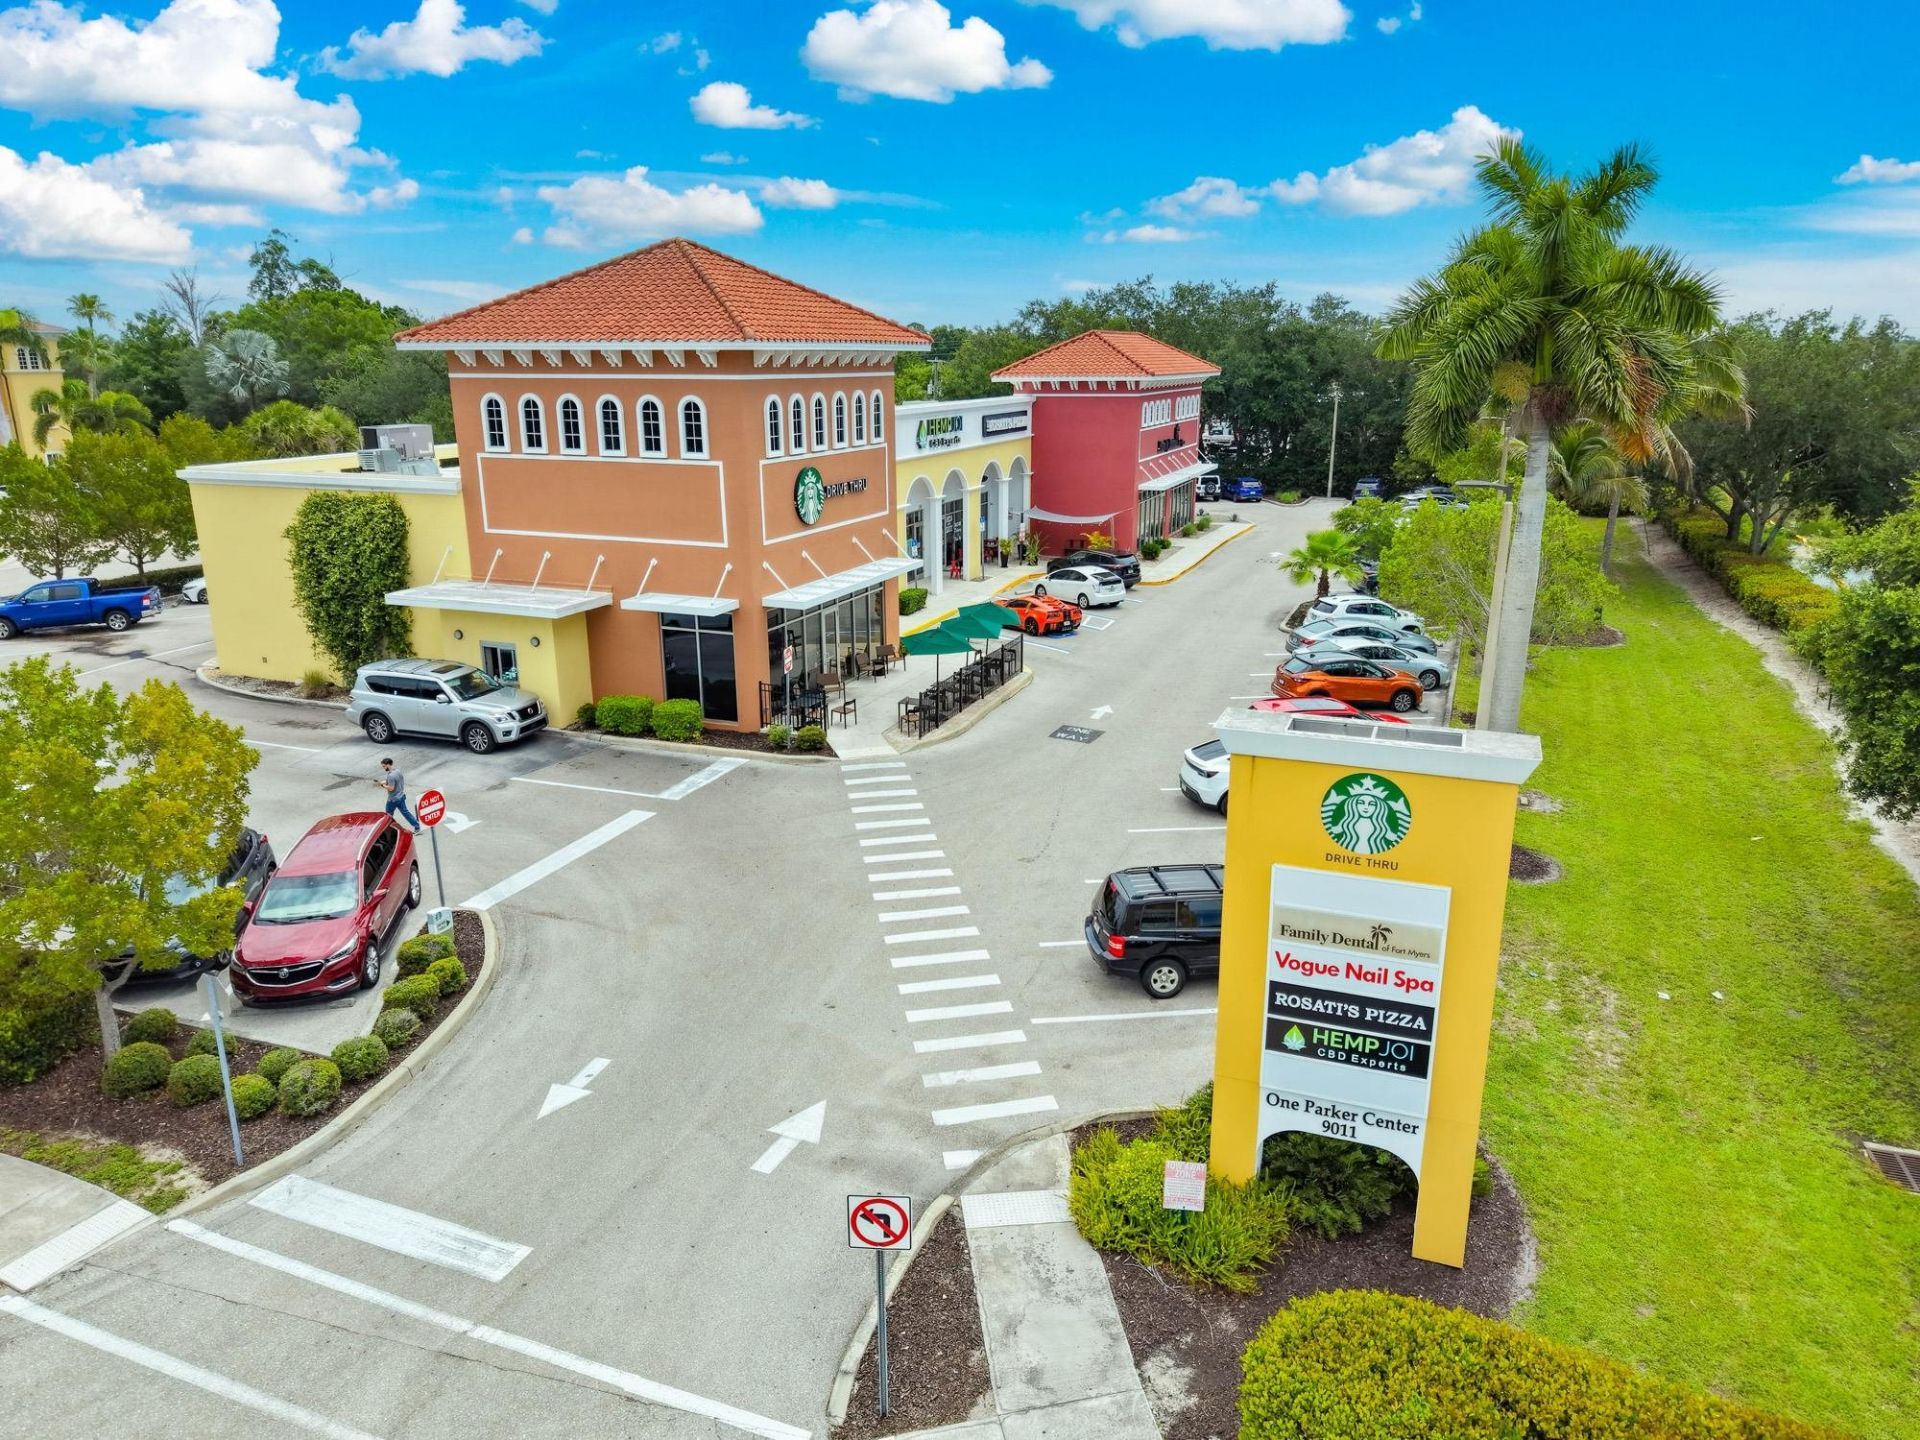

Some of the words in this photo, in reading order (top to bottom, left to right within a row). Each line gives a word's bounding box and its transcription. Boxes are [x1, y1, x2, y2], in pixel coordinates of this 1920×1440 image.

[826, 482, 848, 498] DRIVE
[850, 478, 868, 493] THRU
[421, 799, 428, 807] DO
[430, 795, 440, 804] NOT
[425, 810, 440, 821] ENTER
[1325, 852, 1361, 866] DRIVE
[1366, 858, 1399, 871] THRU
[1280, 924, 1329, 945] Family
[1332, 931, 1379, 950] Dental
[1381, 944, 1390, 952] of
[1391, 945, 1406, 954] Fort
[1407, 949, 1431, 959] Myers
[1275, 951, 1340, 976] Vogue
[1345, 962, 1389, 985] Nail
[1393, 970, 1434, 993] Spa
[1364, 1007, 1427, 1031] PIZZA
[1317, 1047, 1346, 1061] CBD
[1351, 1054, 1407, 1073] Experts
[1265, 1092, 1300, 1111] One
[1303, 1100, 1359, 1123] Parker
[1362, 1111, 1420, 1135] Center
[1322, 1120, 1358, 1139] 9011
